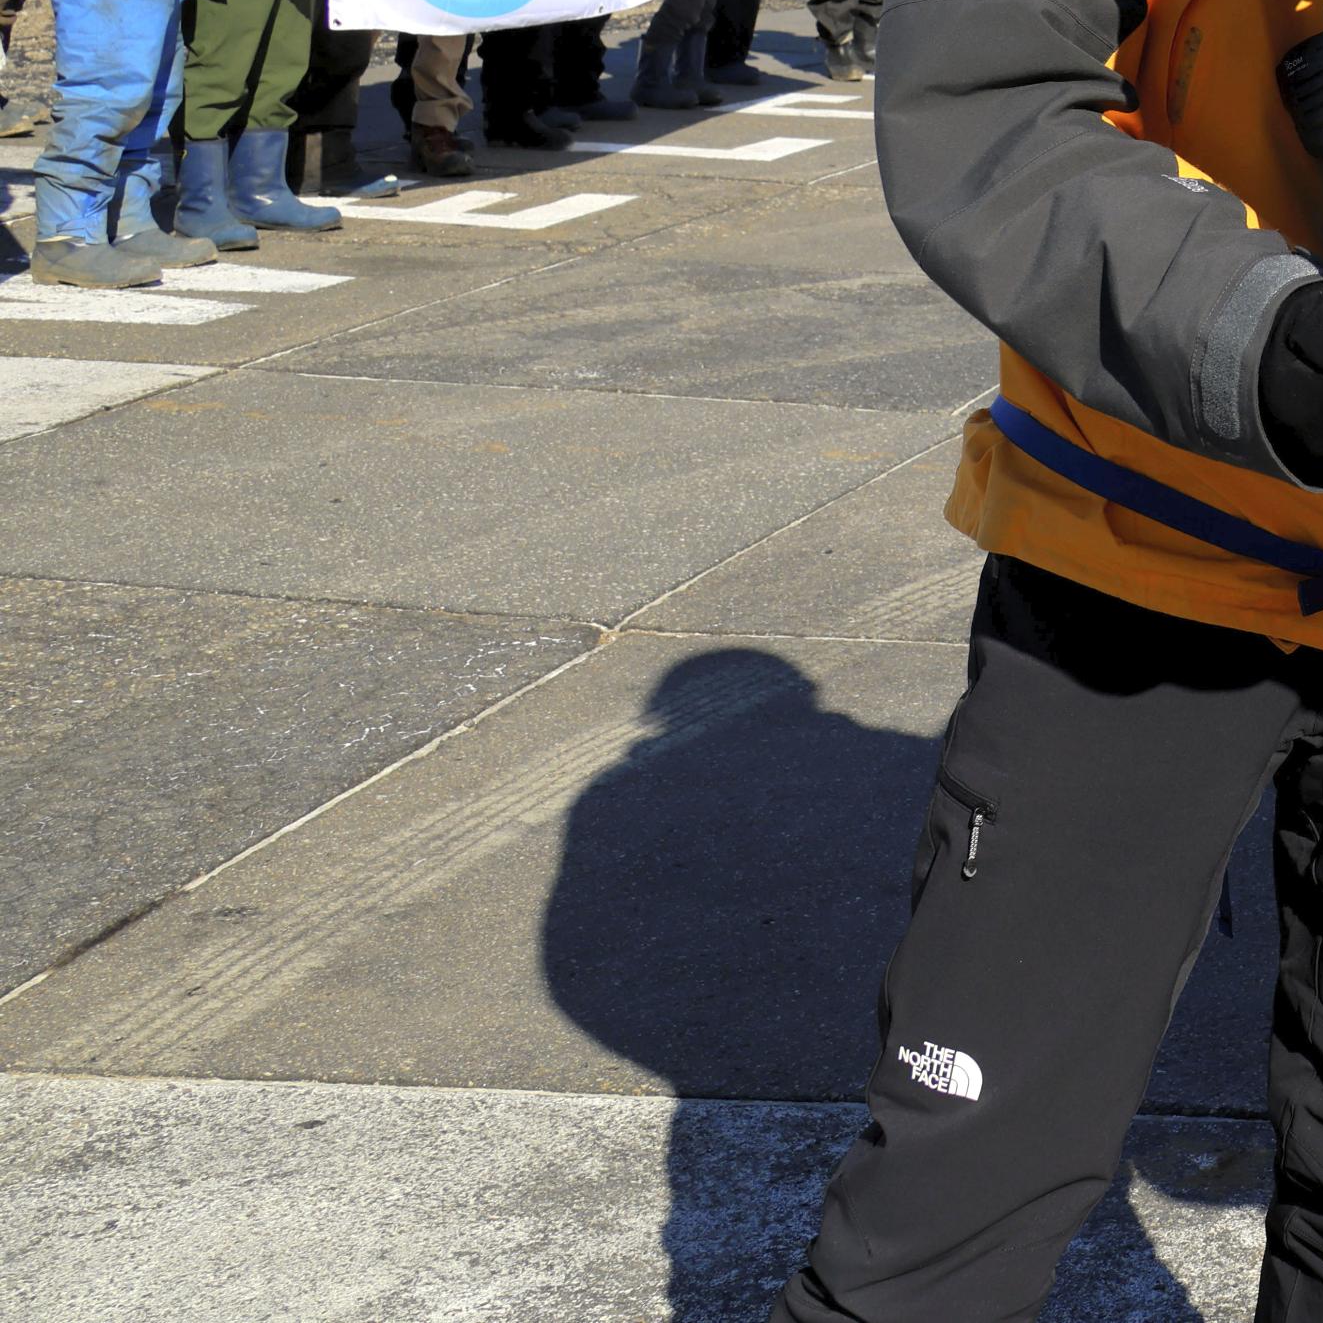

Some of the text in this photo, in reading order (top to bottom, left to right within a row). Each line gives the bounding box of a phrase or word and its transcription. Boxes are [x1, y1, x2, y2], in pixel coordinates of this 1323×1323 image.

[898, 1045, 953, 1080] NORTH
[923, 1040, 956, 1065] THE
[911, 1065, 950, 1094] FACE
